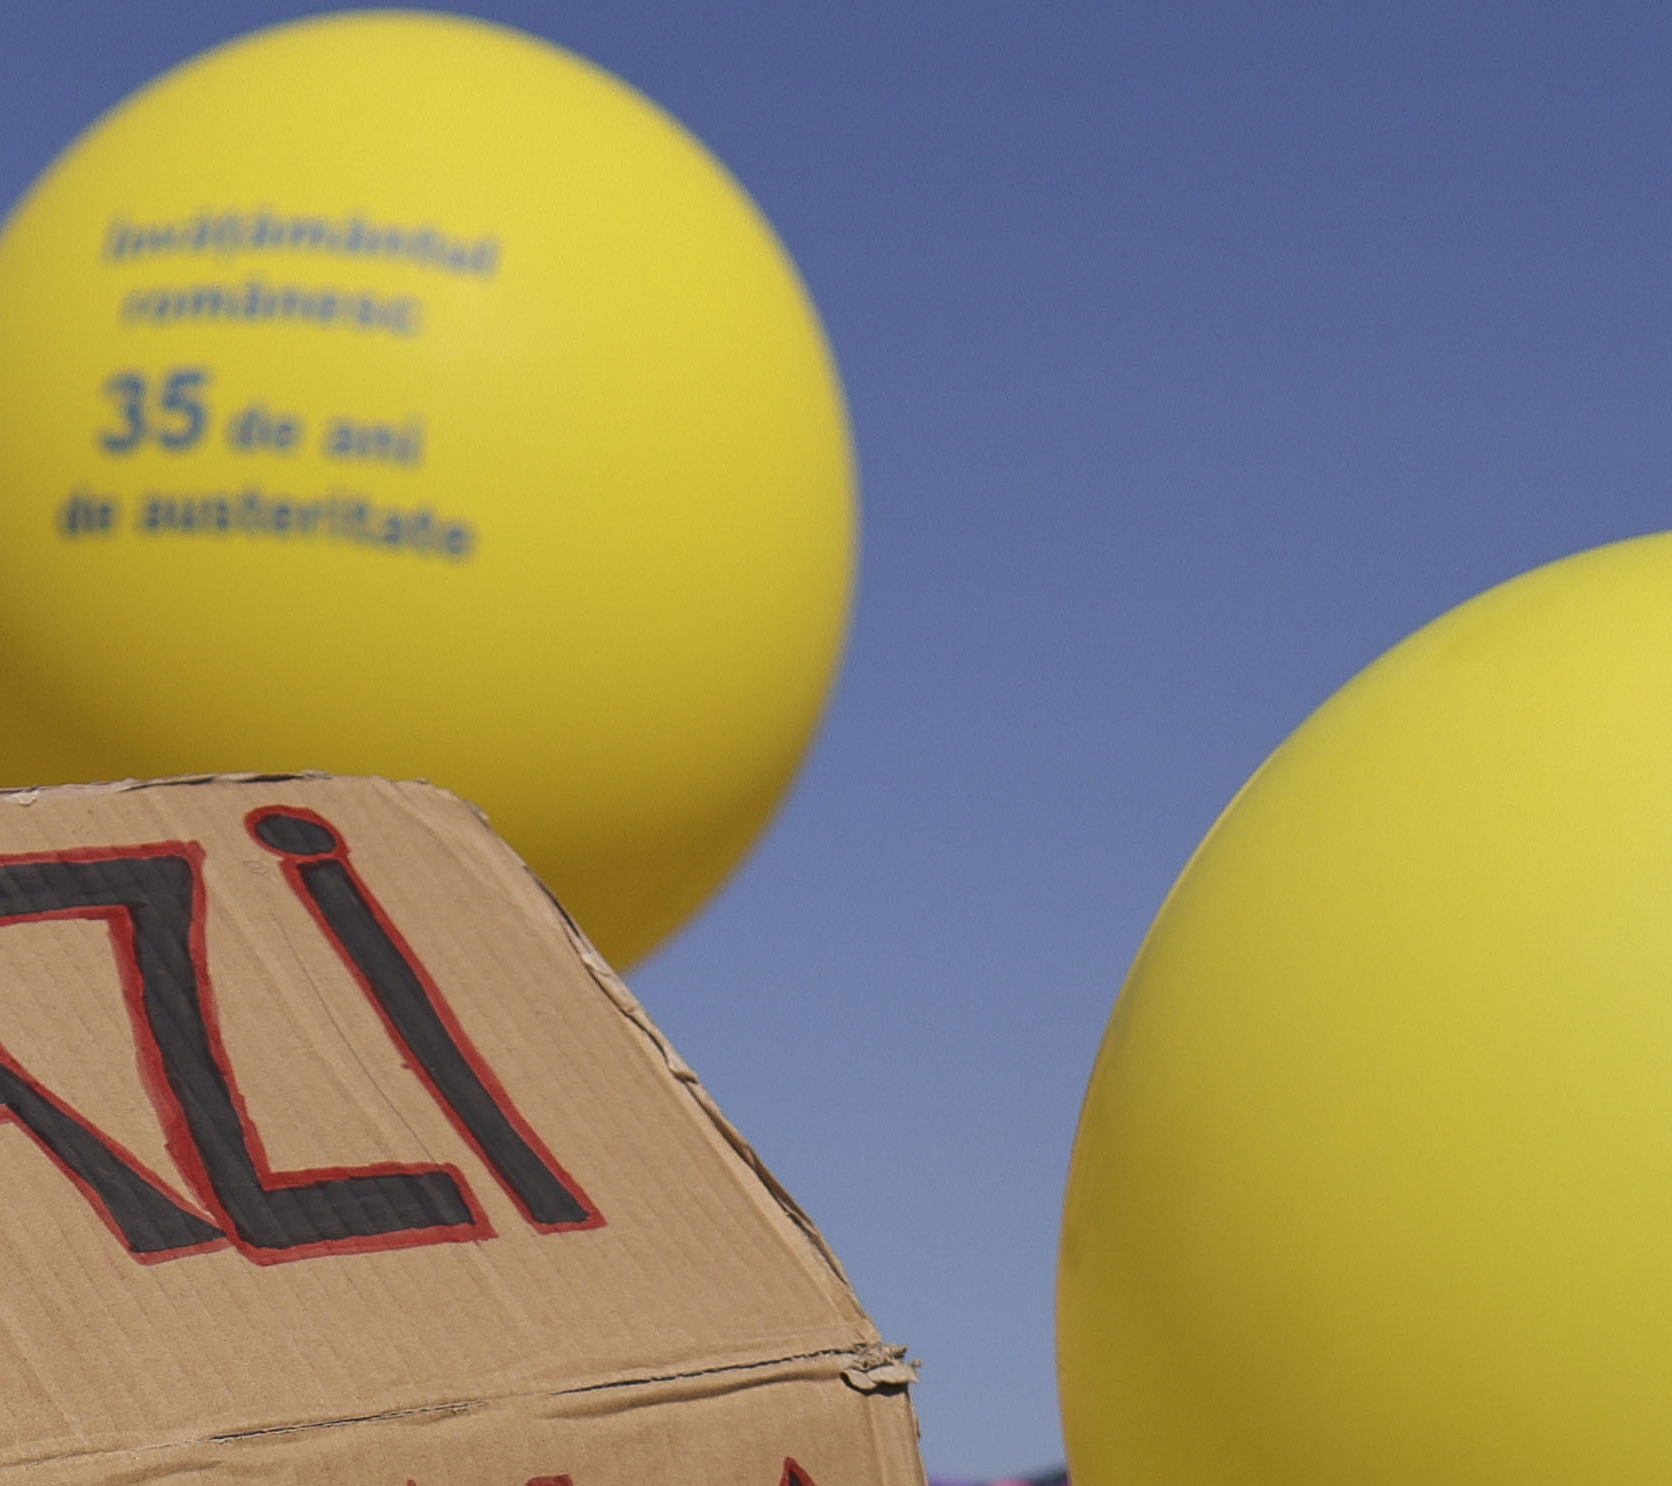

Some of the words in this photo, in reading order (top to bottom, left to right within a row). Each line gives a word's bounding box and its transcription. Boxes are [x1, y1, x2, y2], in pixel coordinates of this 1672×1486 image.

[96, 367, 211, 458] 35
[225, 399, 302, 456] de
[321, 413, 425, 469] ani
[139, 484, 476, 563] austeritate
